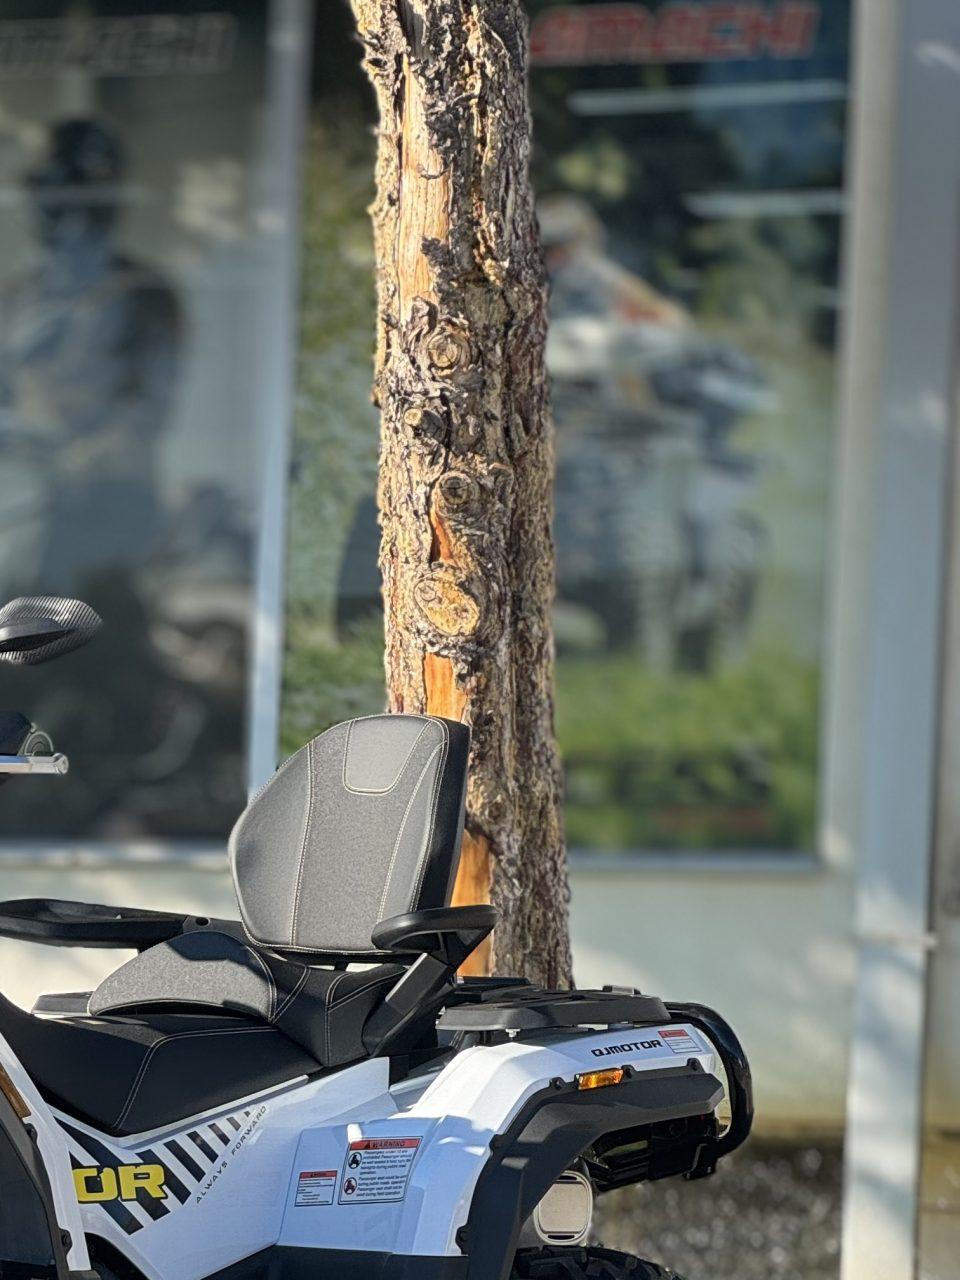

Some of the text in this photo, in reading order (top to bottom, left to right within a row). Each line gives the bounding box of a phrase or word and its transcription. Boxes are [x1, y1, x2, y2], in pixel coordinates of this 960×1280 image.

[591, 1040, 663, 1057] QJMOTOR
[372, 1140, 406, 1148] WARNING
[196, 1105, 267, 1204] ALWAYS FORWARD
